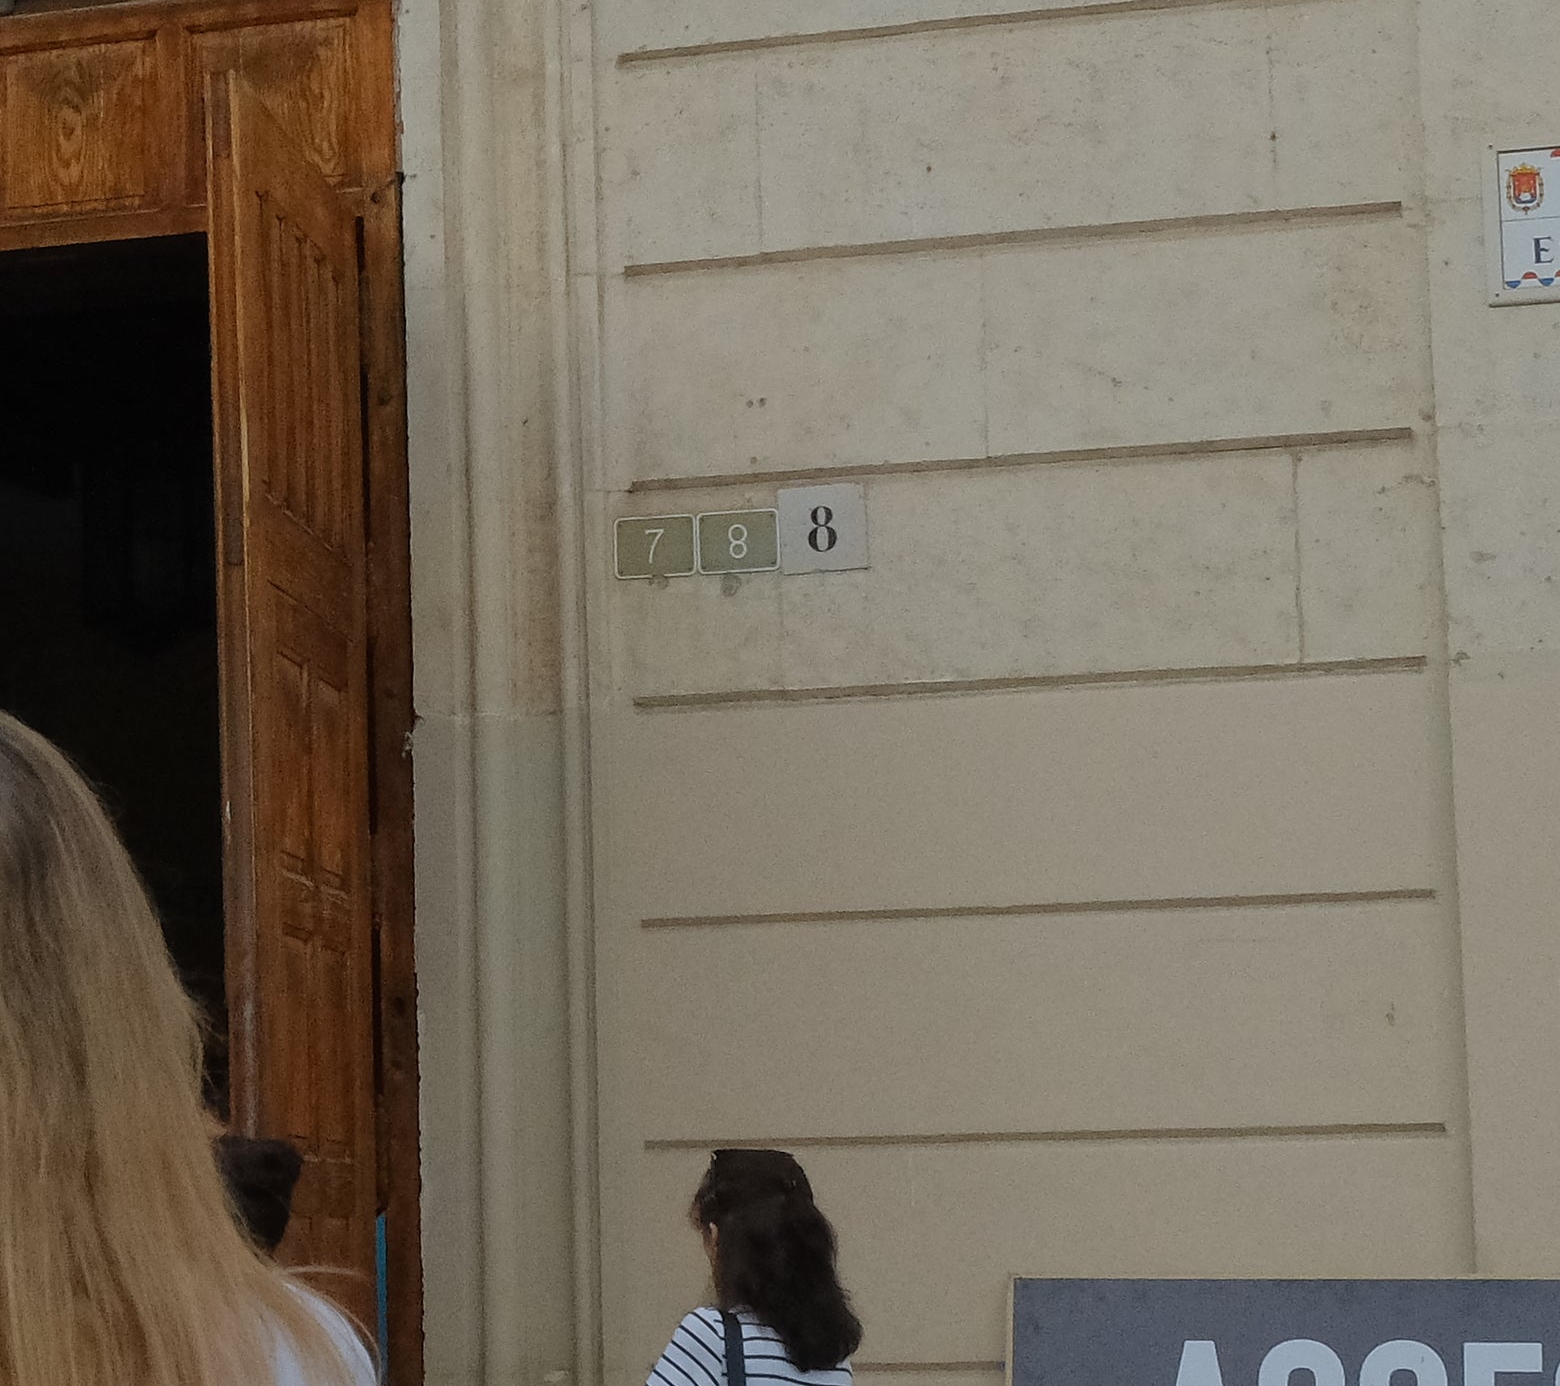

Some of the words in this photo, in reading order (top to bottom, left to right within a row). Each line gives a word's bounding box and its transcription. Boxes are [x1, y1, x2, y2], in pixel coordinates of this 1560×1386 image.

[643, 528, 665, 565] 7
[727, 523, 749, 560] 8
[807, 505, 839, 553] 8
